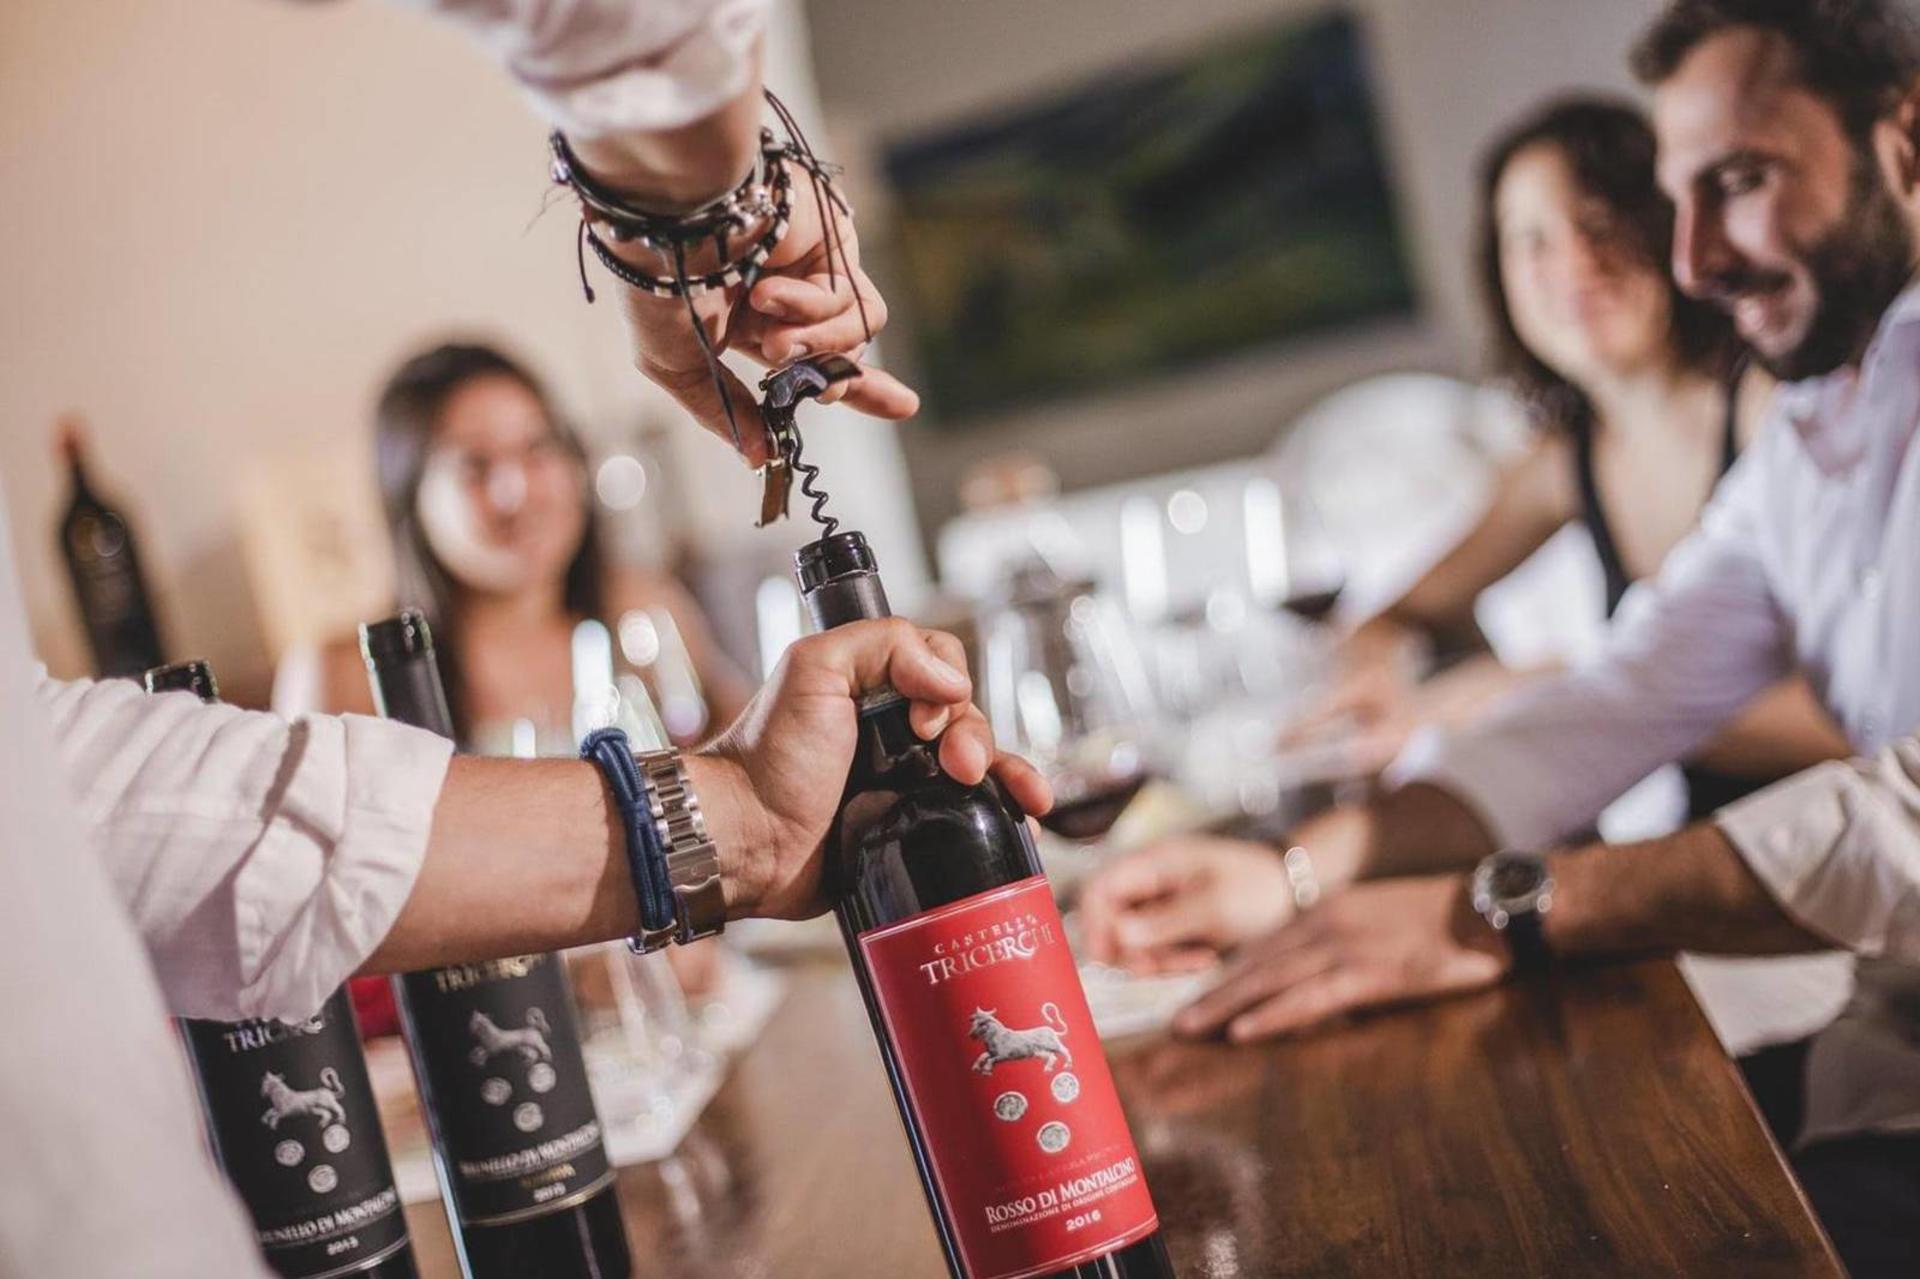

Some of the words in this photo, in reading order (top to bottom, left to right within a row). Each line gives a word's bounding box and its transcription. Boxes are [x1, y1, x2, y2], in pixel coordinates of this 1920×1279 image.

[934, 914, 1037, 954] CASTELLO
[985, 1197, 1036, 1225] ROSSO
[1038, 1189, 1058, 1210] DI
[1059, 1157, 1136, 1203] MONTALCINO
[1065, 1209, 1102, 1232] 2016
